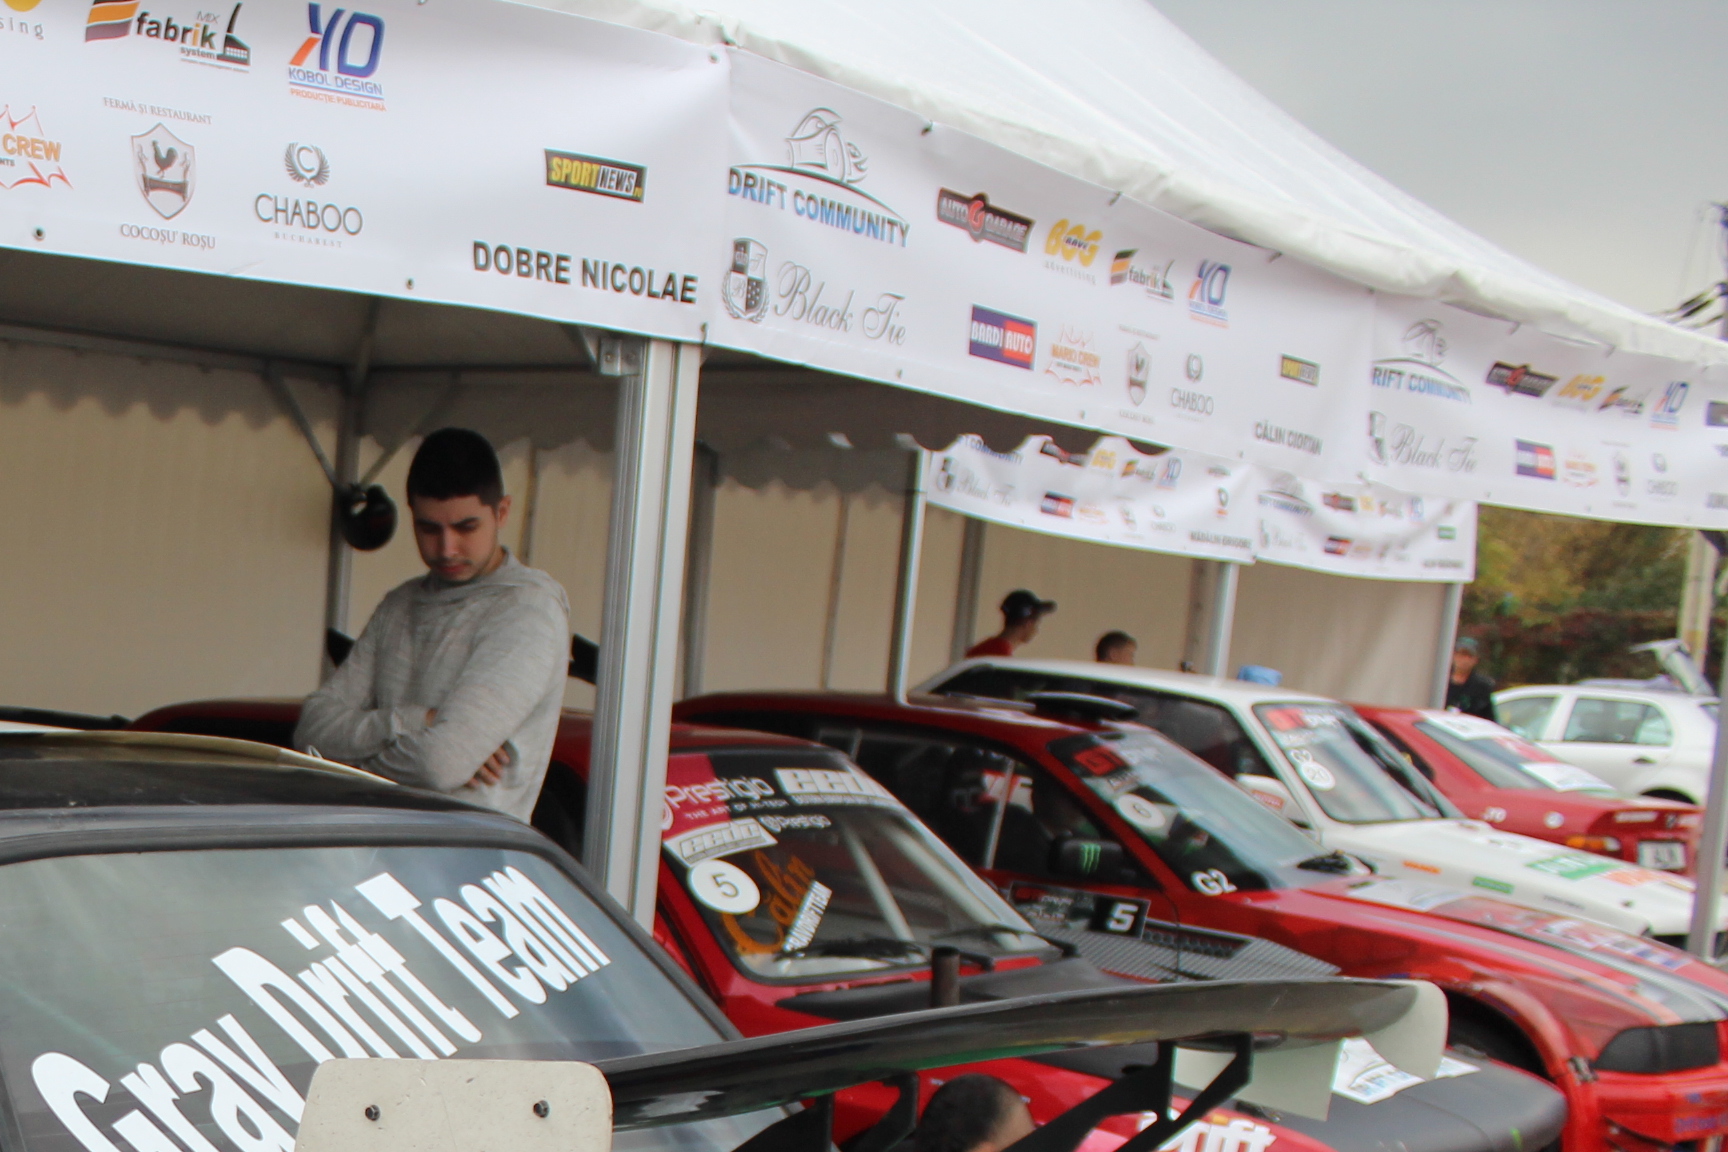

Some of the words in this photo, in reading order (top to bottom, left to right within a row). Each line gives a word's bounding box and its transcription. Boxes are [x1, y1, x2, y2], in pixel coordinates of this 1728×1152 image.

[137, 11, 217, 50] fabrik
[289, 67, 331, 86] KOBOL
[334, 76, 383, 95] DESIGN
[150, 105, 212, 124] RESTAURANT
[2, 131, 62, 162] CREW
[254, 193, 363, 235] CHABOO
[728, 167, 788, 209] DRIFT
[793, 189, 910, 247] COMMUNITY
[274, 231, 343, 248] BUCHAREST
[473, 240, 571, 284] DOBRE
[581, 258, 698, 304] NICOLAE
[775, 261, 854, 332] Black
[862, 292, 907, 345] Tie
[972, 320, 1003, 348] BARDI
[1005, 329, 1034, 356] AUTO
[666, 775, 775, 808] Prestigio
[712, 873, 740, 898] 5
[1191, 867, 1237, 897] G2
[1105, 902, 1139, 933] 5
[212, 900, 483, 1060] Drift
[355, 866, 611, 1020] Team
